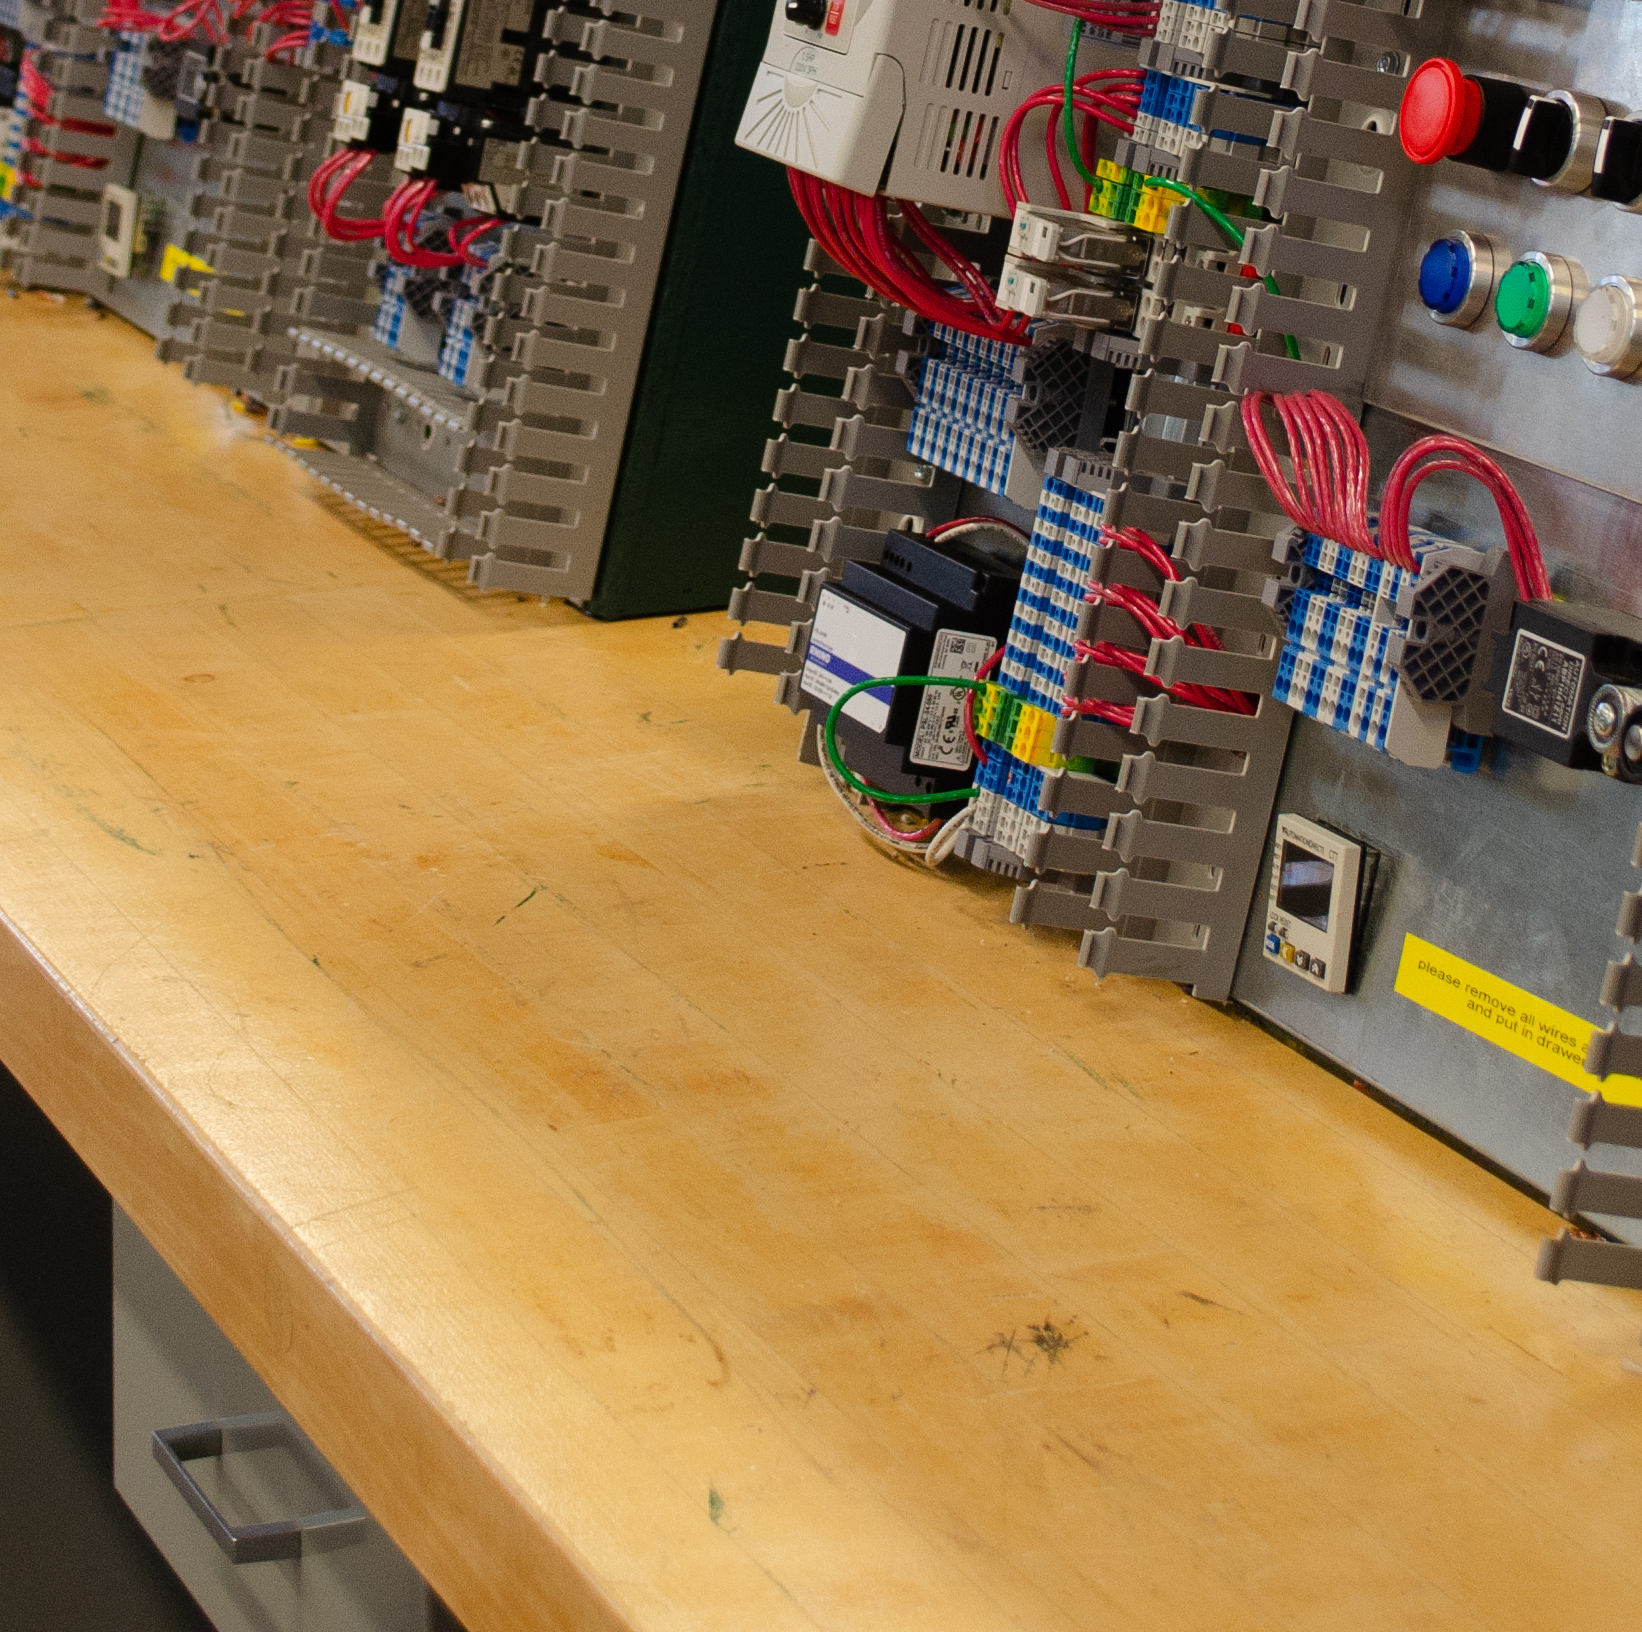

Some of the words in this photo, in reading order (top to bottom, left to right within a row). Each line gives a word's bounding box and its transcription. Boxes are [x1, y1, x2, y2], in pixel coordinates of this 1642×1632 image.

[1562, 659, 1581, 731] AUTOMATION
[1418, 958, 1461, 989] please
[1464, 982, 1517, 1017] remove
[1520, 1009, 1536, 1027] all
[1539, 1020, 1577, 1048] wires
[1466, 998, 1492, 1019] and
[1495, 1014, 1518, 1035] put
[1521, 1026, 1533, 1041] in
[1536, 1034, 1586, 1067] drawe
